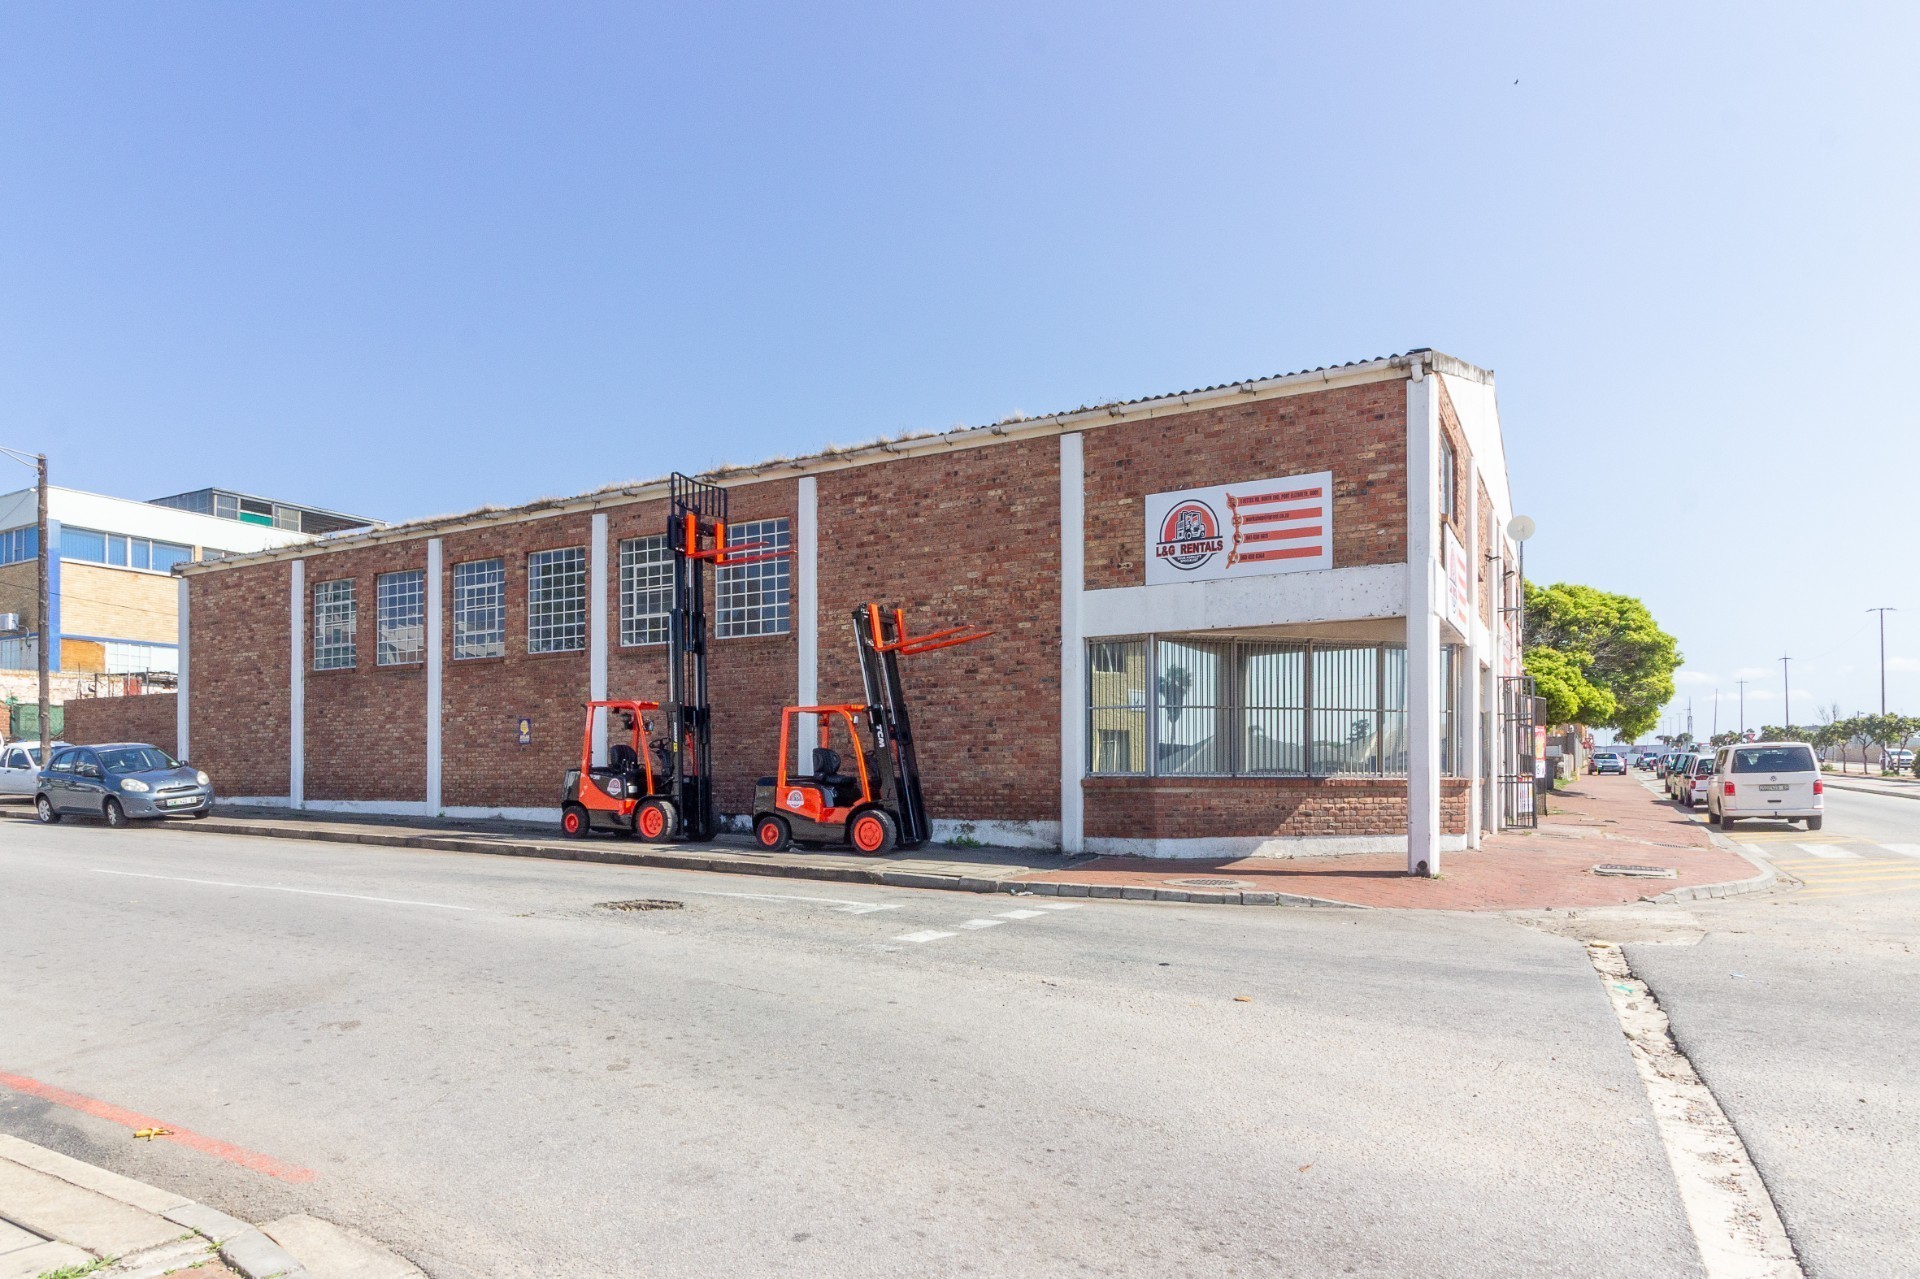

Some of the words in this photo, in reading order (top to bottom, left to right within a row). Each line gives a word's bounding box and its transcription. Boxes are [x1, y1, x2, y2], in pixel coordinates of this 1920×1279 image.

[1156, 545, 1175, 558] L&G
[1180, 540, 1223, 555] RENTALS
[875, 723, 886, 748] TCM
